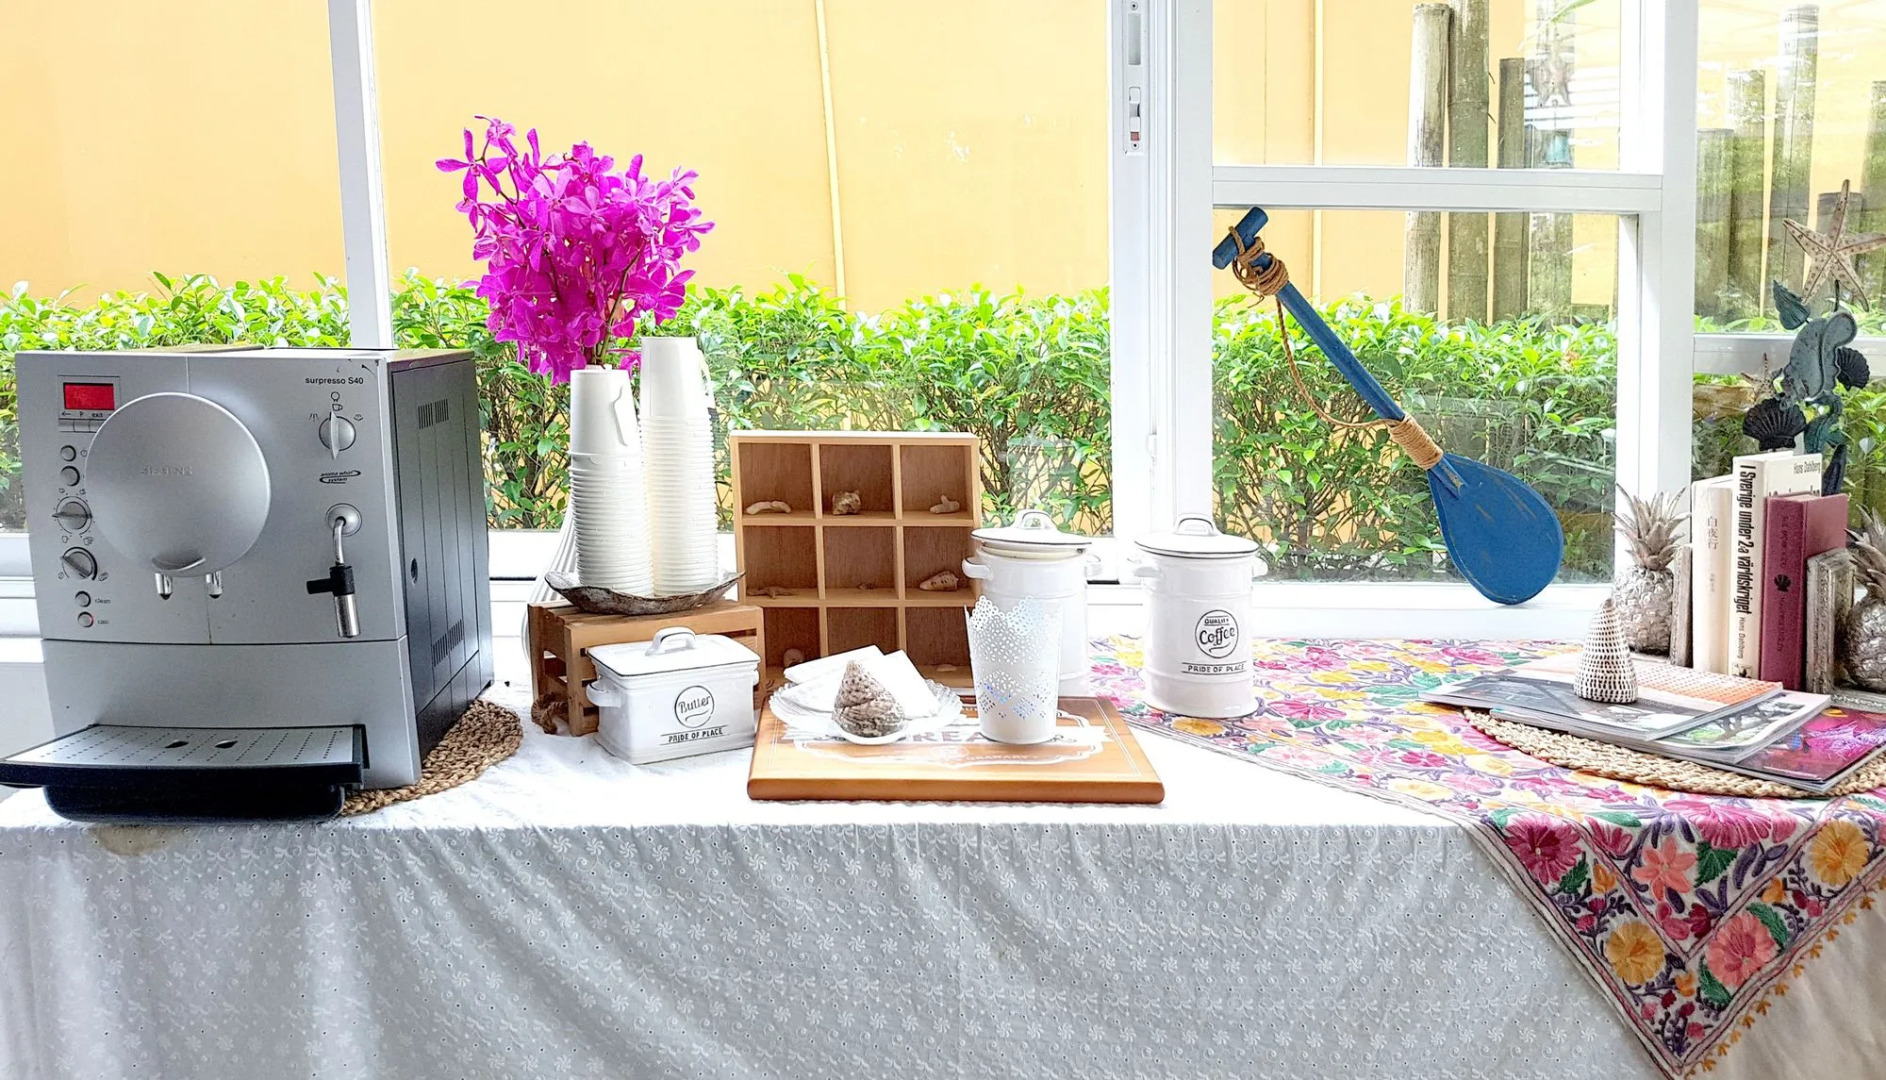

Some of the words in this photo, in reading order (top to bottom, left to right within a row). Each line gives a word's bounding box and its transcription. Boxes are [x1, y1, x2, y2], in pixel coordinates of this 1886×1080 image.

[305, 377, 346, 385] surpresso
[348, 376, 364, 384] S40
[1736, 471, 1757, 509] Sverige
[1738, 511, 1755, 540] under
[1733, 556, 1755, 615] världskriget
[1738, 617, 1746, 632] Hans
[1199, 627, 1236, 646] Coffee
[1737, 632, 1746, 659] Dahlberg
[1187, 664, 1211, 673] PRIDE
[1226, 664, 1245, 672] PLACE
[678, 695, 711, 714] Butter
[668, 733, 689, 743] PRIDE
[691, 731, 700, 739] OF
[702, 727, 723, 738] PLACE
